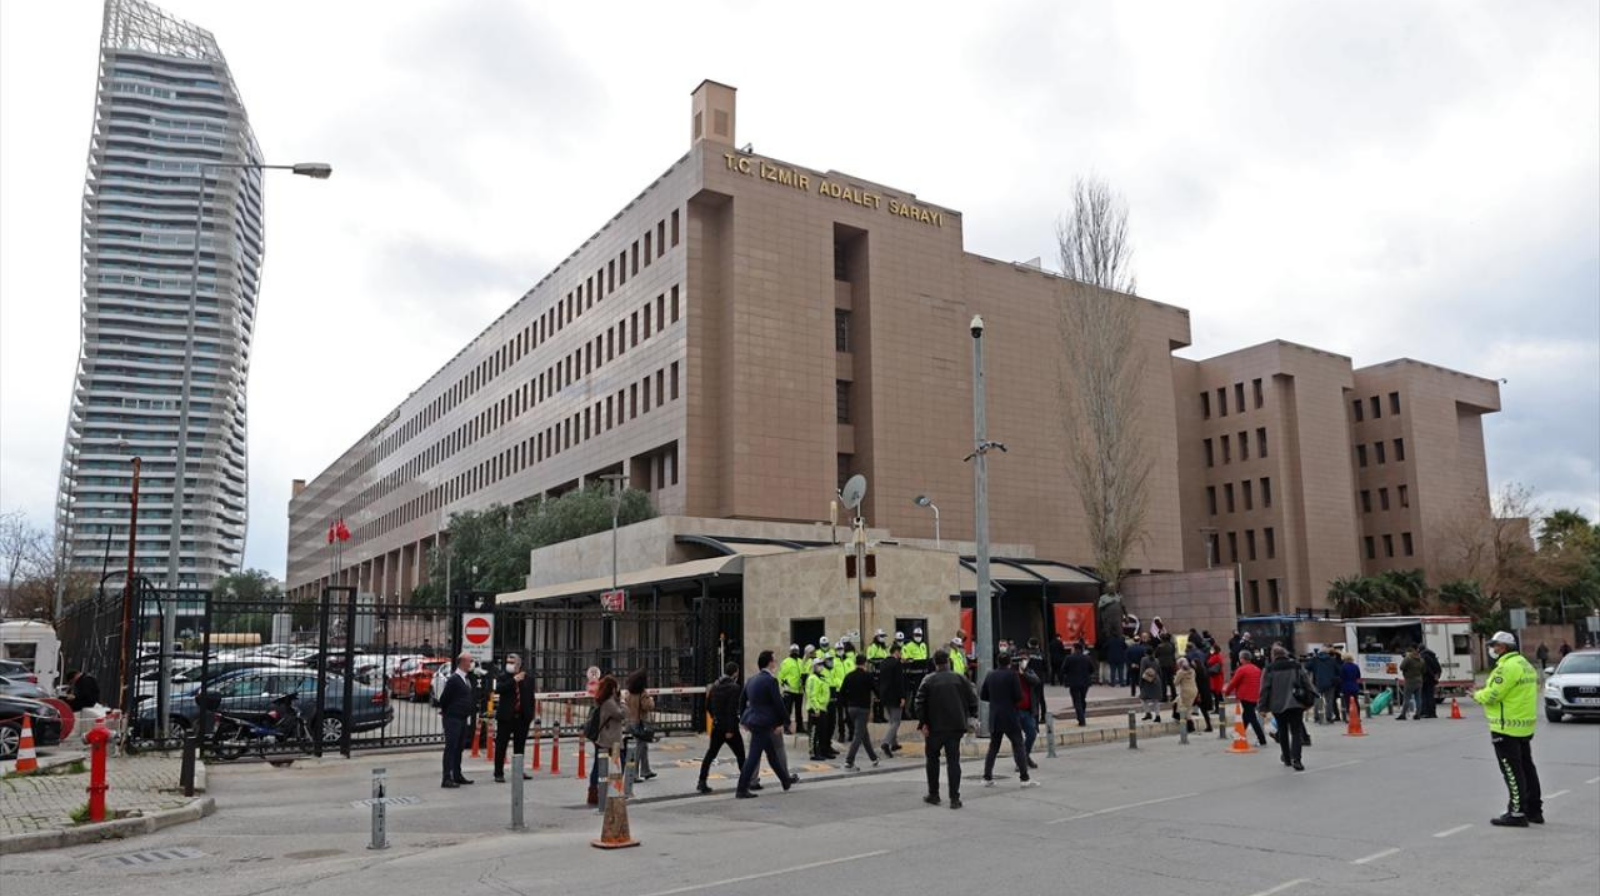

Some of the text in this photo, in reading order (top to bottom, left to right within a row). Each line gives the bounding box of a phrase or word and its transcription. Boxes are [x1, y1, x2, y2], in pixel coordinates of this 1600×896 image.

[760, 161, 810, 191] İZMİR
[819, 181, 881, 209] ADALET
[889, 199, 943, 226] SARAYI
